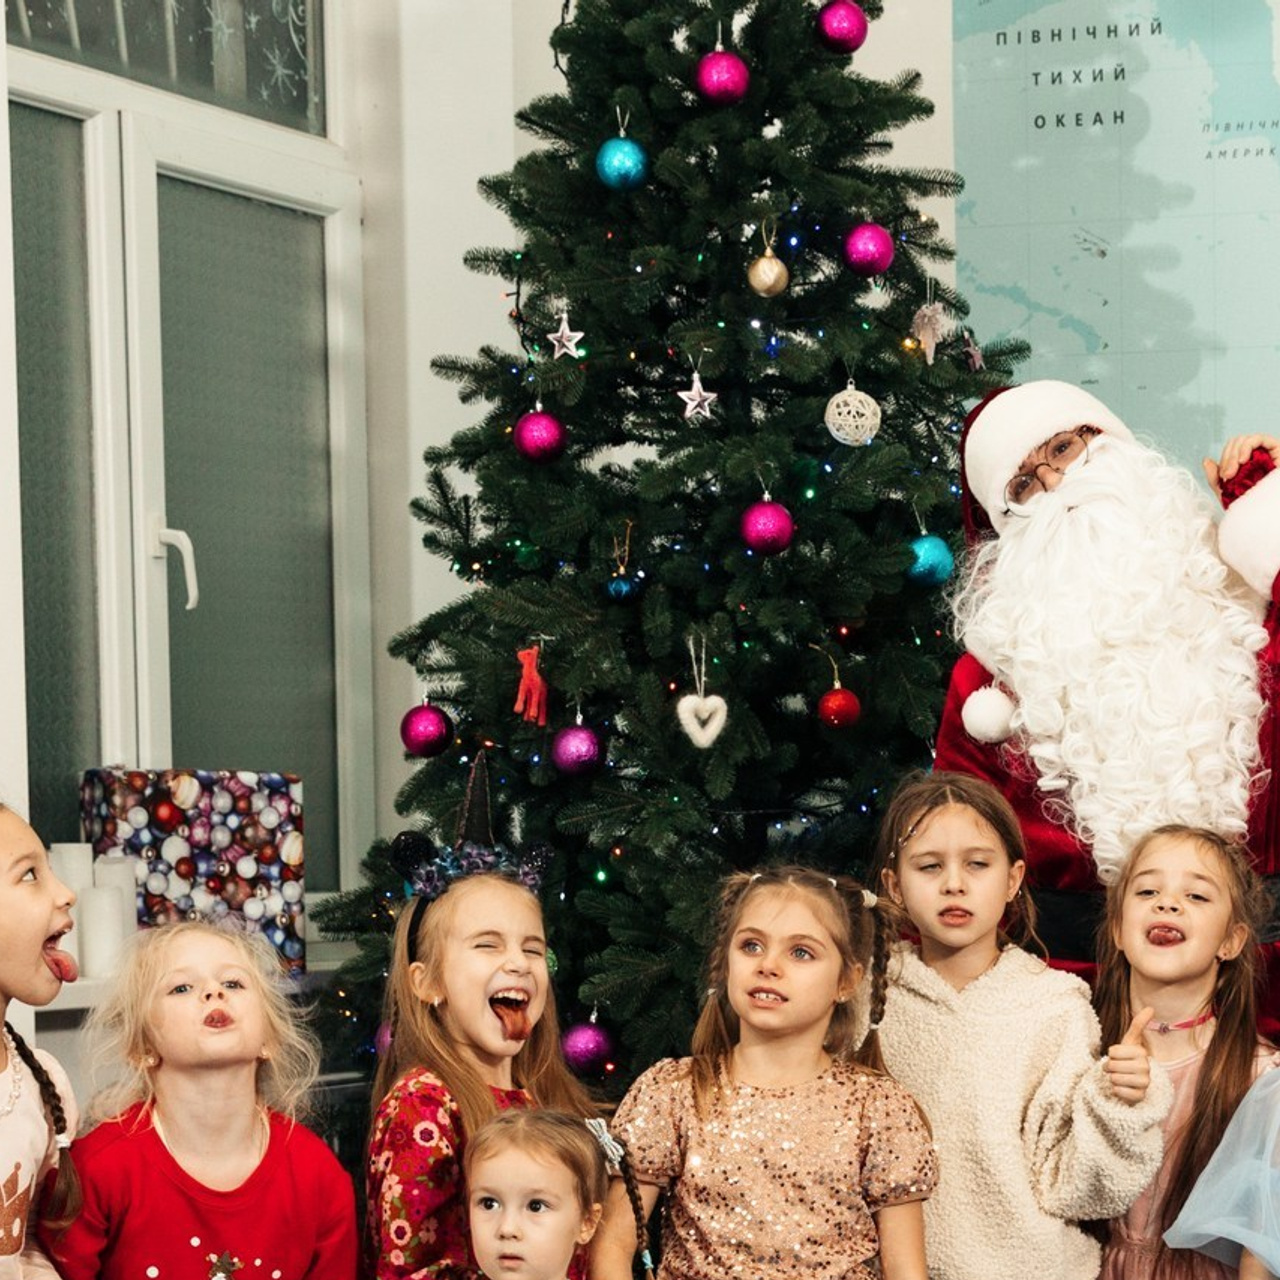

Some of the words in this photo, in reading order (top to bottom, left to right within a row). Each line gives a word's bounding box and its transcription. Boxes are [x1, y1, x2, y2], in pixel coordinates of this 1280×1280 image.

[996, 22, 1163, 46] ПІВНІЧНИЙ
[1032, 64, 1126, 86] ТИХИЙ
[1034, 111, 1126, 129] ОКЕАН
